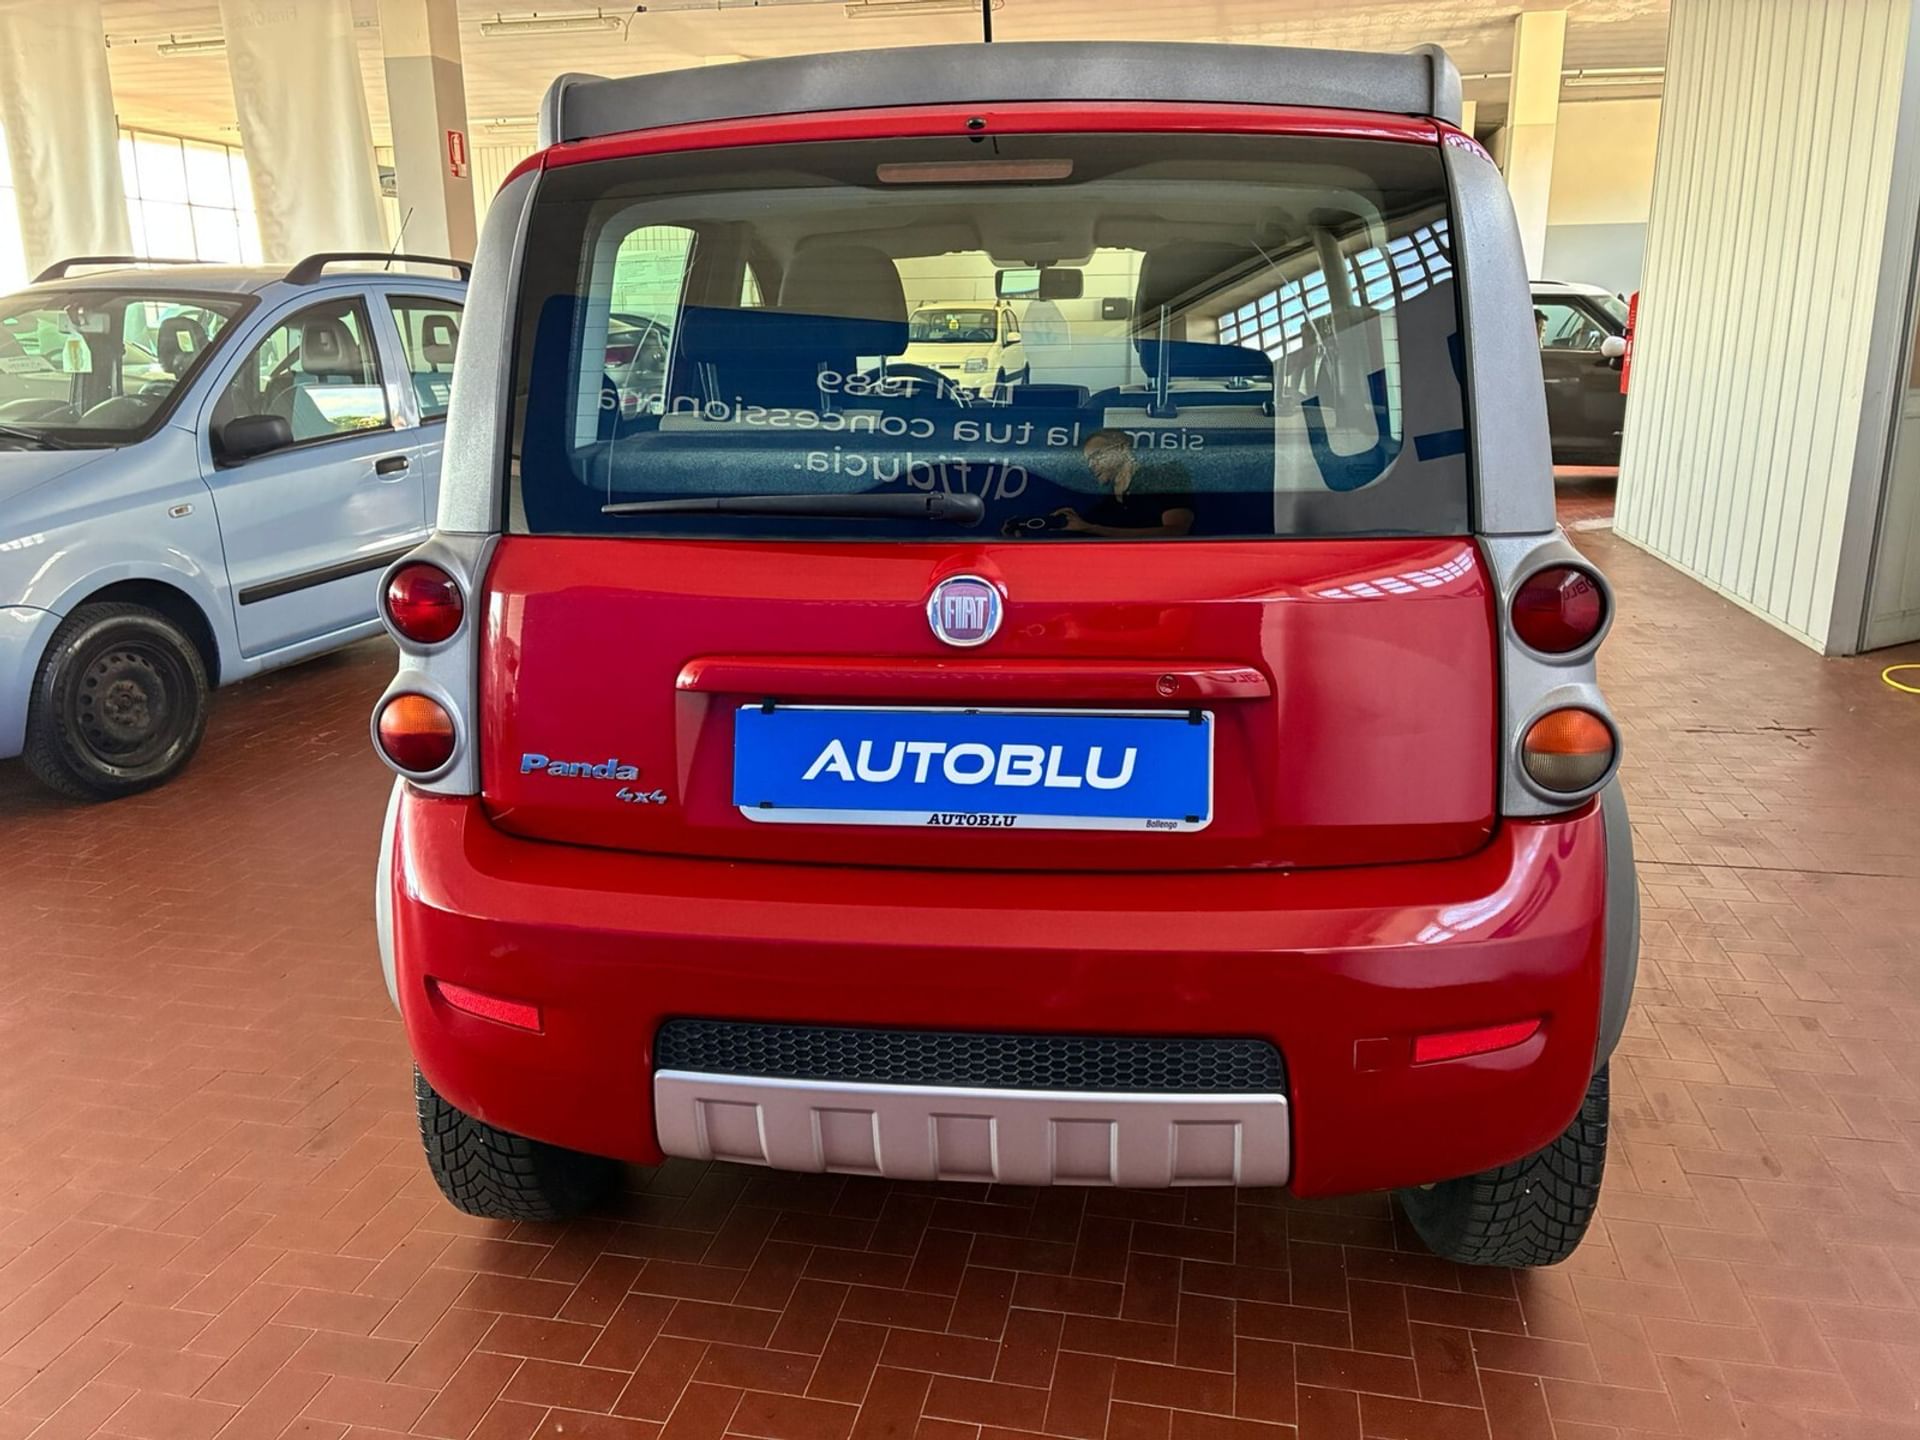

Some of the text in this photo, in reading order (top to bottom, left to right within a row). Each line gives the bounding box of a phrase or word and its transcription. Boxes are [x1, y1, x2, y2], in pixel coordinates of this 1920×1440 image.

[945, 596, 987, 629] FIAT
[520, 753, 640, 781] Panda
[801, 738, 1138, 790] AUTOBLU
[615, 787, 668, 804] 4x4
[927, 812, 1017, 828] AUTOBLU
